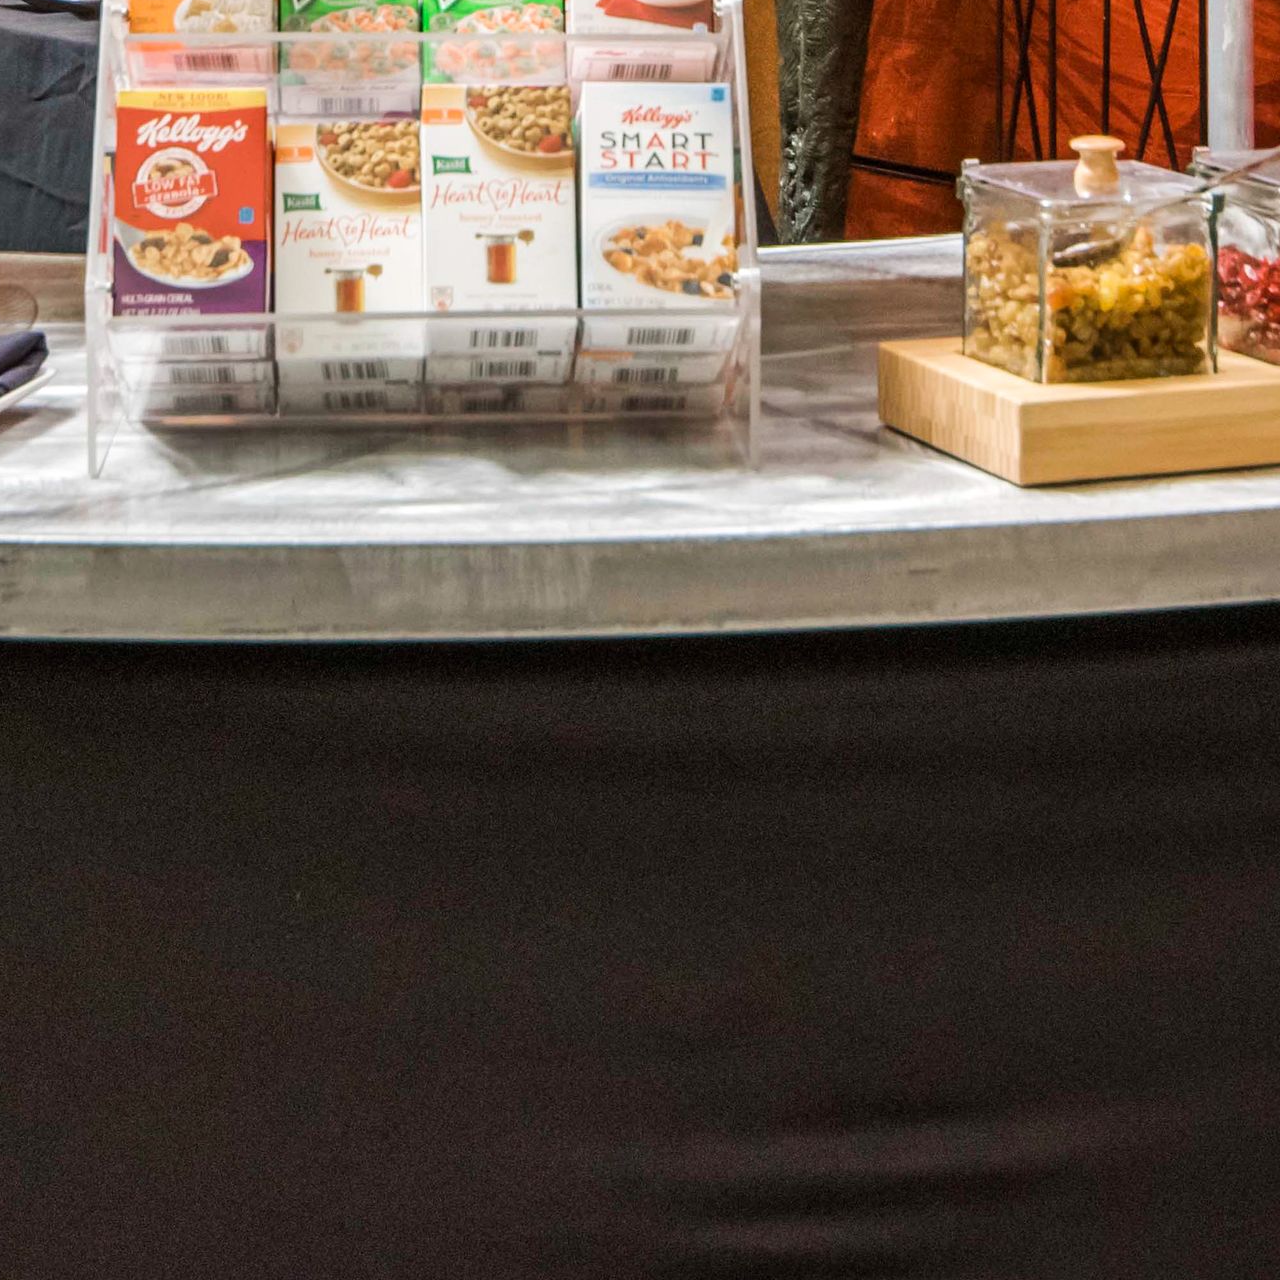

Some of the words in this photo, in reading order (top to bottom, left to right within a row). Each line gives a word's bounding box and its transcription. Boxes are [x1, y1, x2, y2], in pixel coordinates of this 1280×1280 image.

[621, 104, 693, 129] Kellogg's
[136, 113, 249, 152] Kellogg's
[599, 131, 713, 150] SMART
[435, 160, 465, 172] Kashi
[600, 150, 719, 170] START
[144, 176, 176, 194] LOW
[605, 174, 645, 184] Original
[431, 182, 485, 208] Heart
[496, 187, 509, 201] to
[507, 181, 562, 208] Heart
[281, 218, 335, 247] Heart
[344, 221, 359, 236] to
[357, 215, 412, 243] Heart
